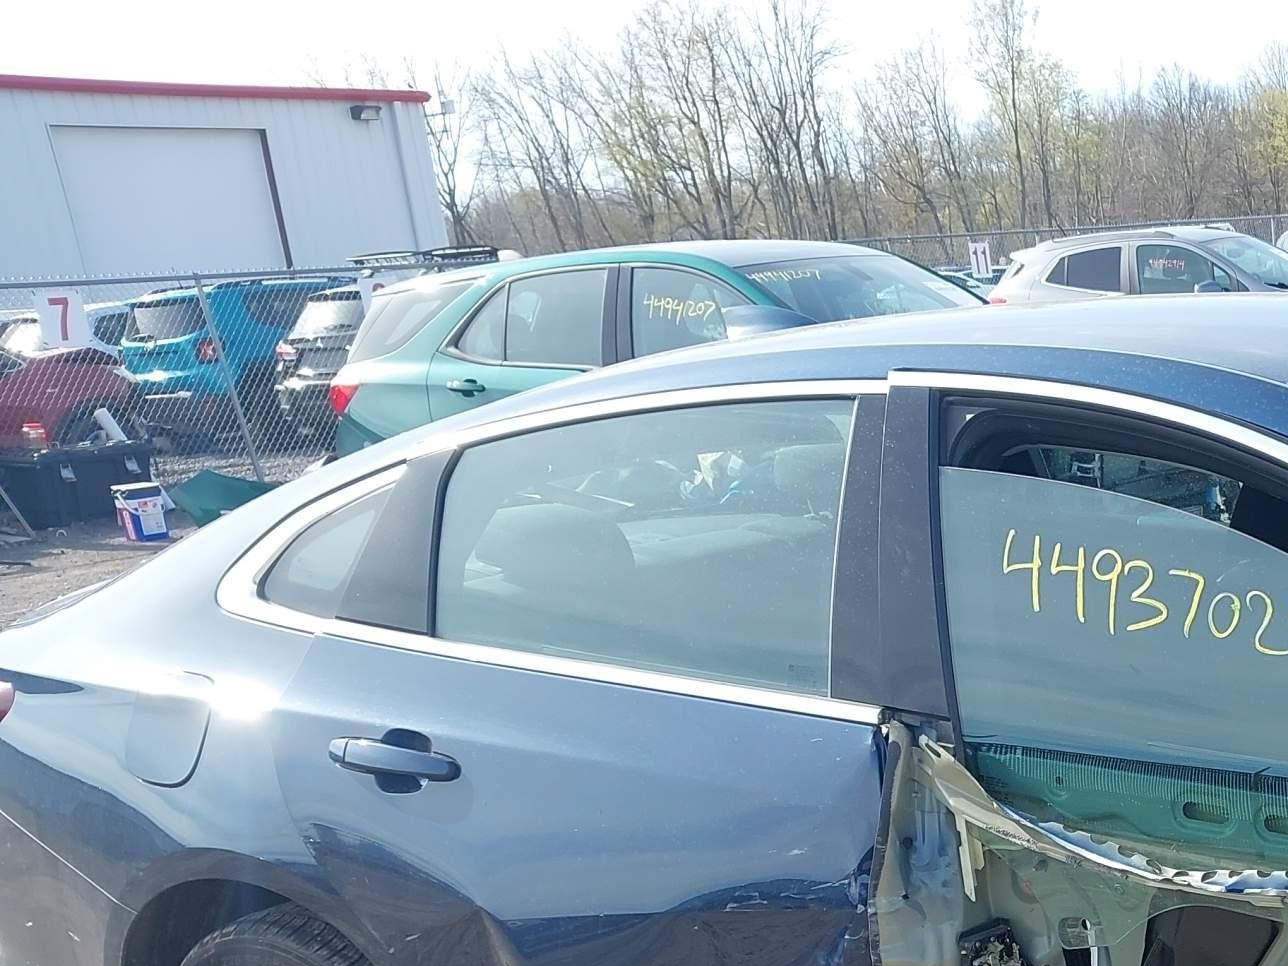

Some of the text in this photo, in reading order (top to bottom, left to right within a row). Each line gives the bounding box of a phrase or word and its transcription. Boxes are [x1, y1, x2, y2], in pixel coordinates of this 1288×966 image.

[972, 246, 989, 274] 11
[48, 297, 69, 341] 7
[643, 293, 716, 326] 44941207
